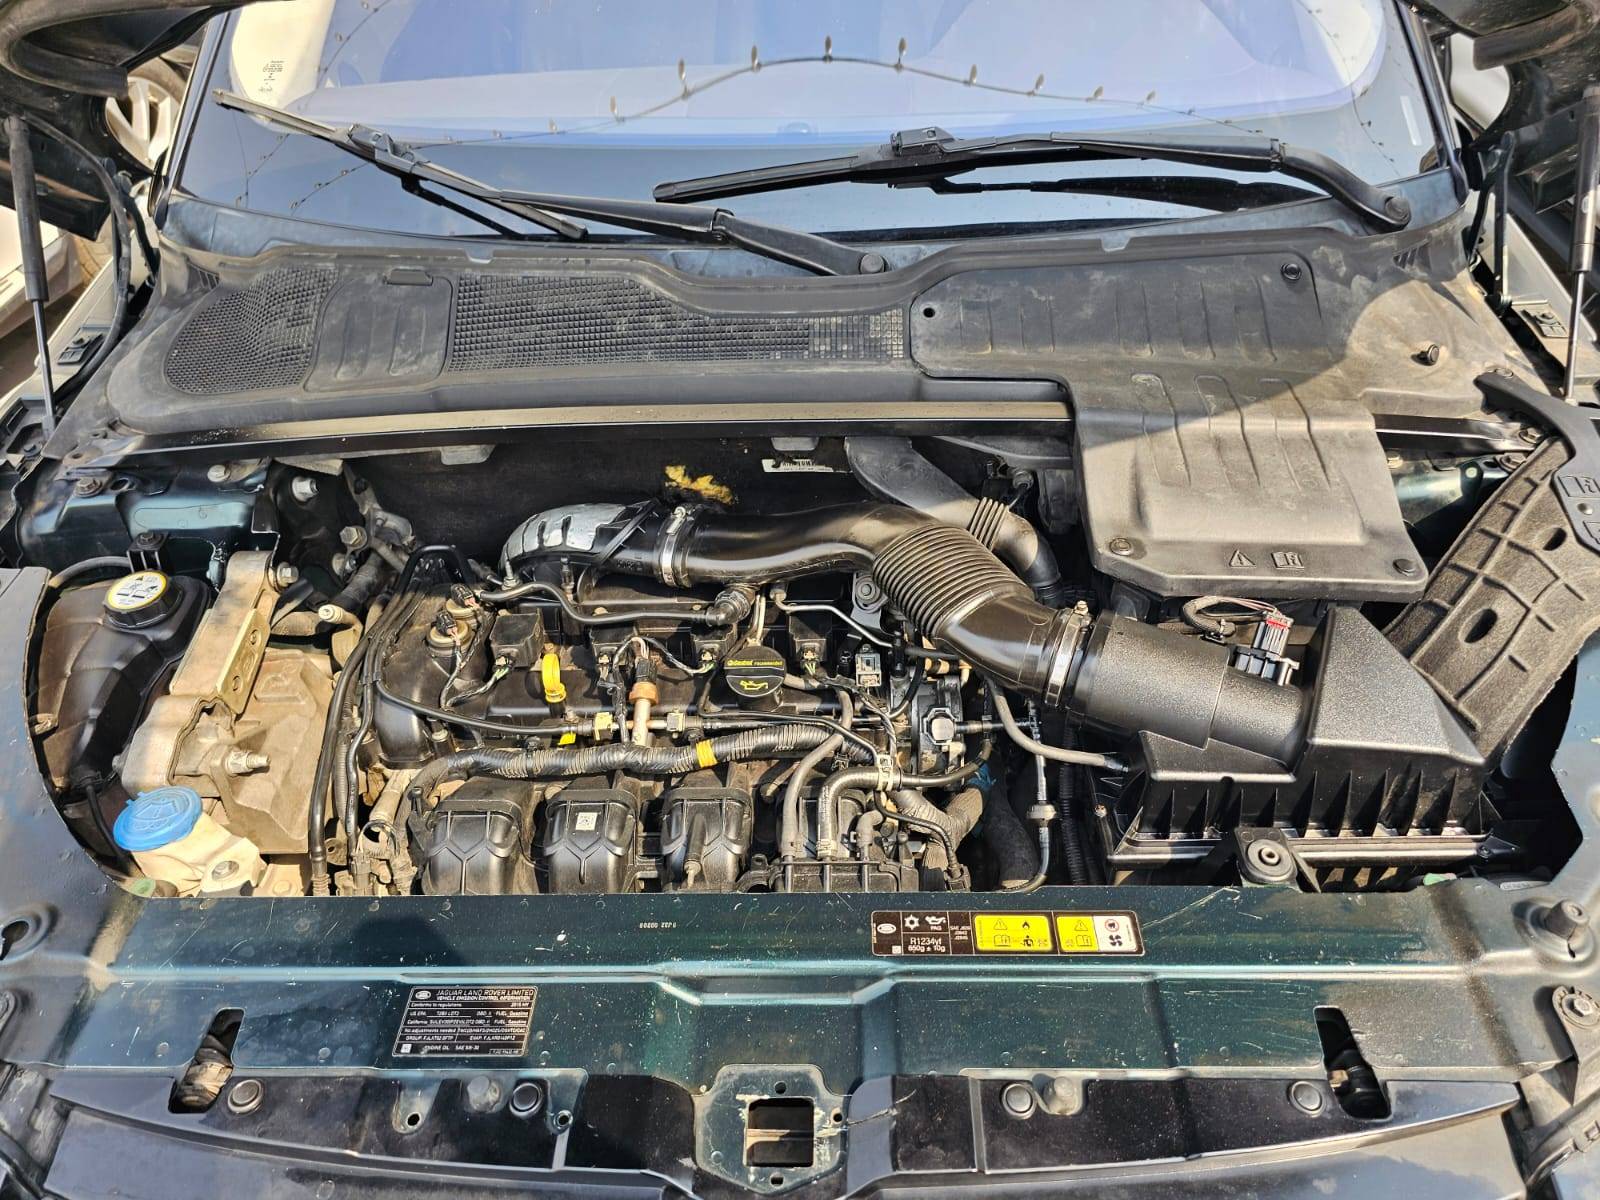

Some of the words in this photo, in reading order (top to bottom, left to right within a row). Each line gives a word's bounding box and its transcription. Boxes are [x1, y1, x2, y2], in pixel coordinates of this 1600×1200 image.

[910, 937, 942, 945] R1234yf
[908, 945, 925, 953] 650g
[934, 945, 946, 953] 10g
